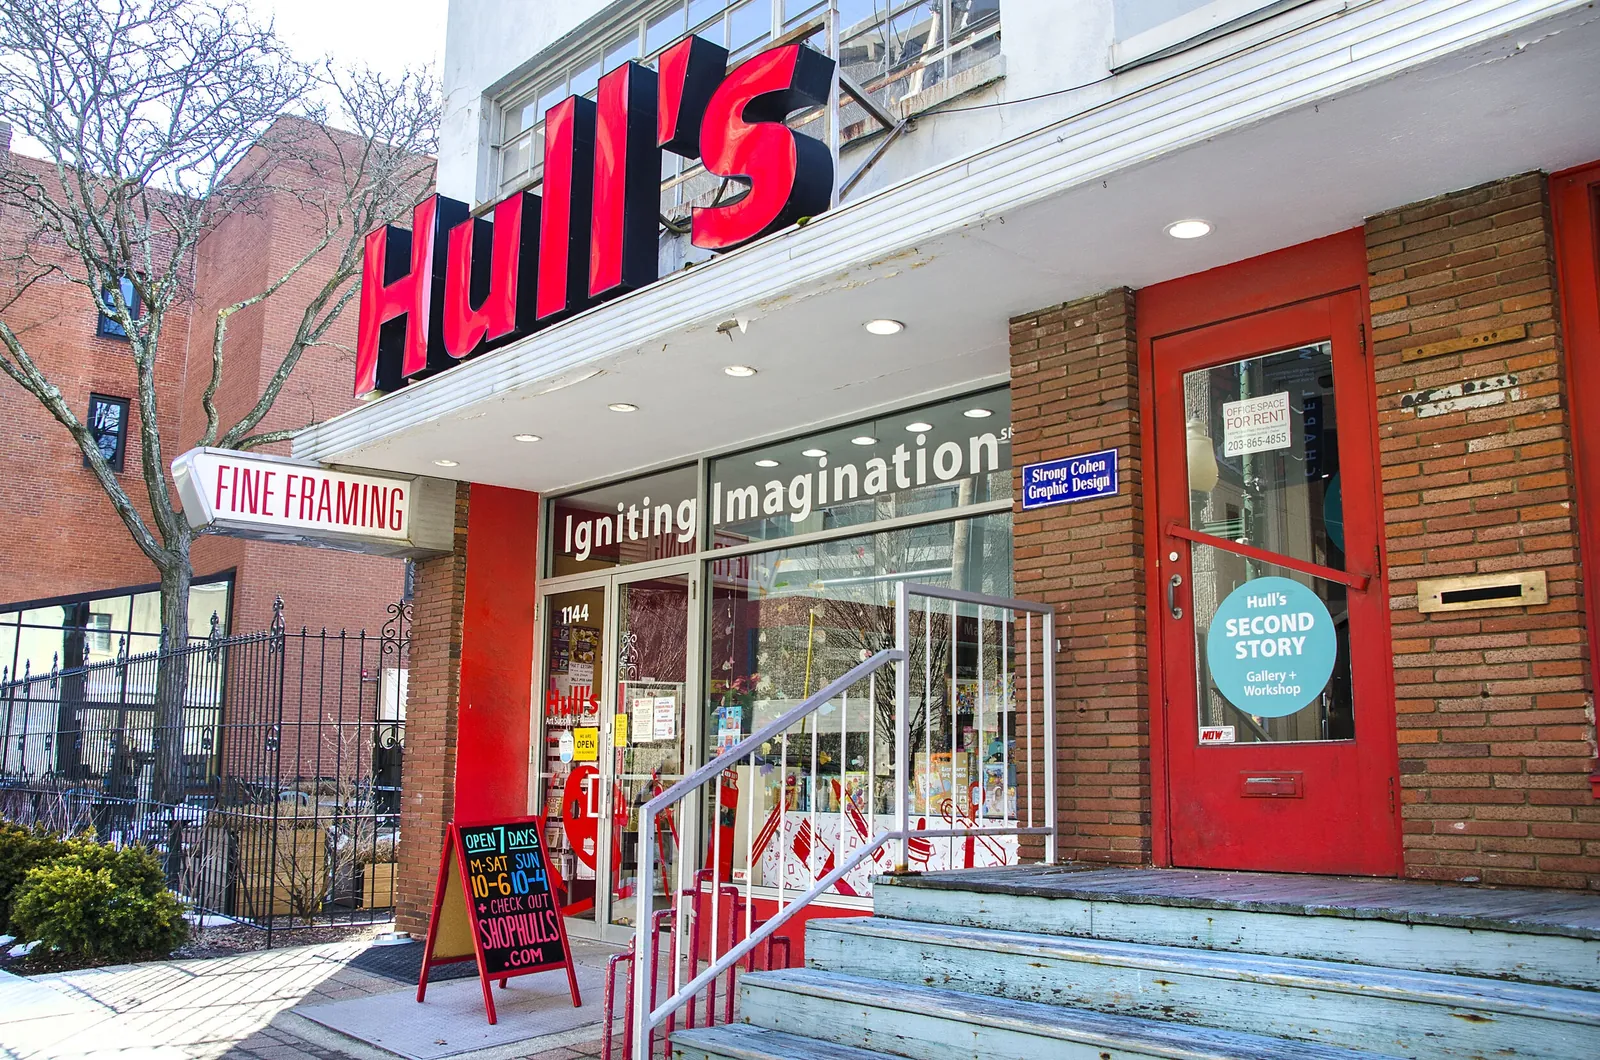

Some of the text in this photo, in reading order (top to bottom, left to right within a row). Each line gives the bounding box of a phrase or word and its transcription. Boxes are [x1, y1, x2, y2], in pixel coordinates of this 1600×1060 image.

[354, 35, 806, 399] Hull's
[1227, 399, 1285, 417] OFFICE SPACE
[1227, 416, 1251, 429] FOR
[1254, 409, 1286, 425] RENT
[1227, 433, 1287, 451] 203-865-4855
[1032, 459, 1106, 483] Strong Cohen
[564, 496, 698, 560] Igniting
[713, 432, 999, 526] Imagination
[1028, 474, 1110, 500] Graphic Design
[215, 465, 404, 531] FINE FRAMING
[1247, 592, 1287, 608] Hull's
[561, 604, 589, 625] 1144
[1225, 612, 1315, 637] SECOND
[1235, 636, 1306, 660] STORY
[1246, 670, 1297, 683] Gallery +
[1244, 683, 1301, 696] Workshop
[546, 685, 598, 717] Hull's
[577, 740, 595, 749] OPEN
[1202, 730, 1223, 740] NOW
[465, 826, 538, 853] OPEN 7 DAYS
[470, 852, 541, 873] M-SAT SUN
[471, 868, 549, 898] 10-6 10-4
[490, 896, 524, 914] CHECK
[528, 893, 549, 909] OUT
[478, 909, 560, 950] SHOPHULLS
[504, 947, 544, 967] .COM
